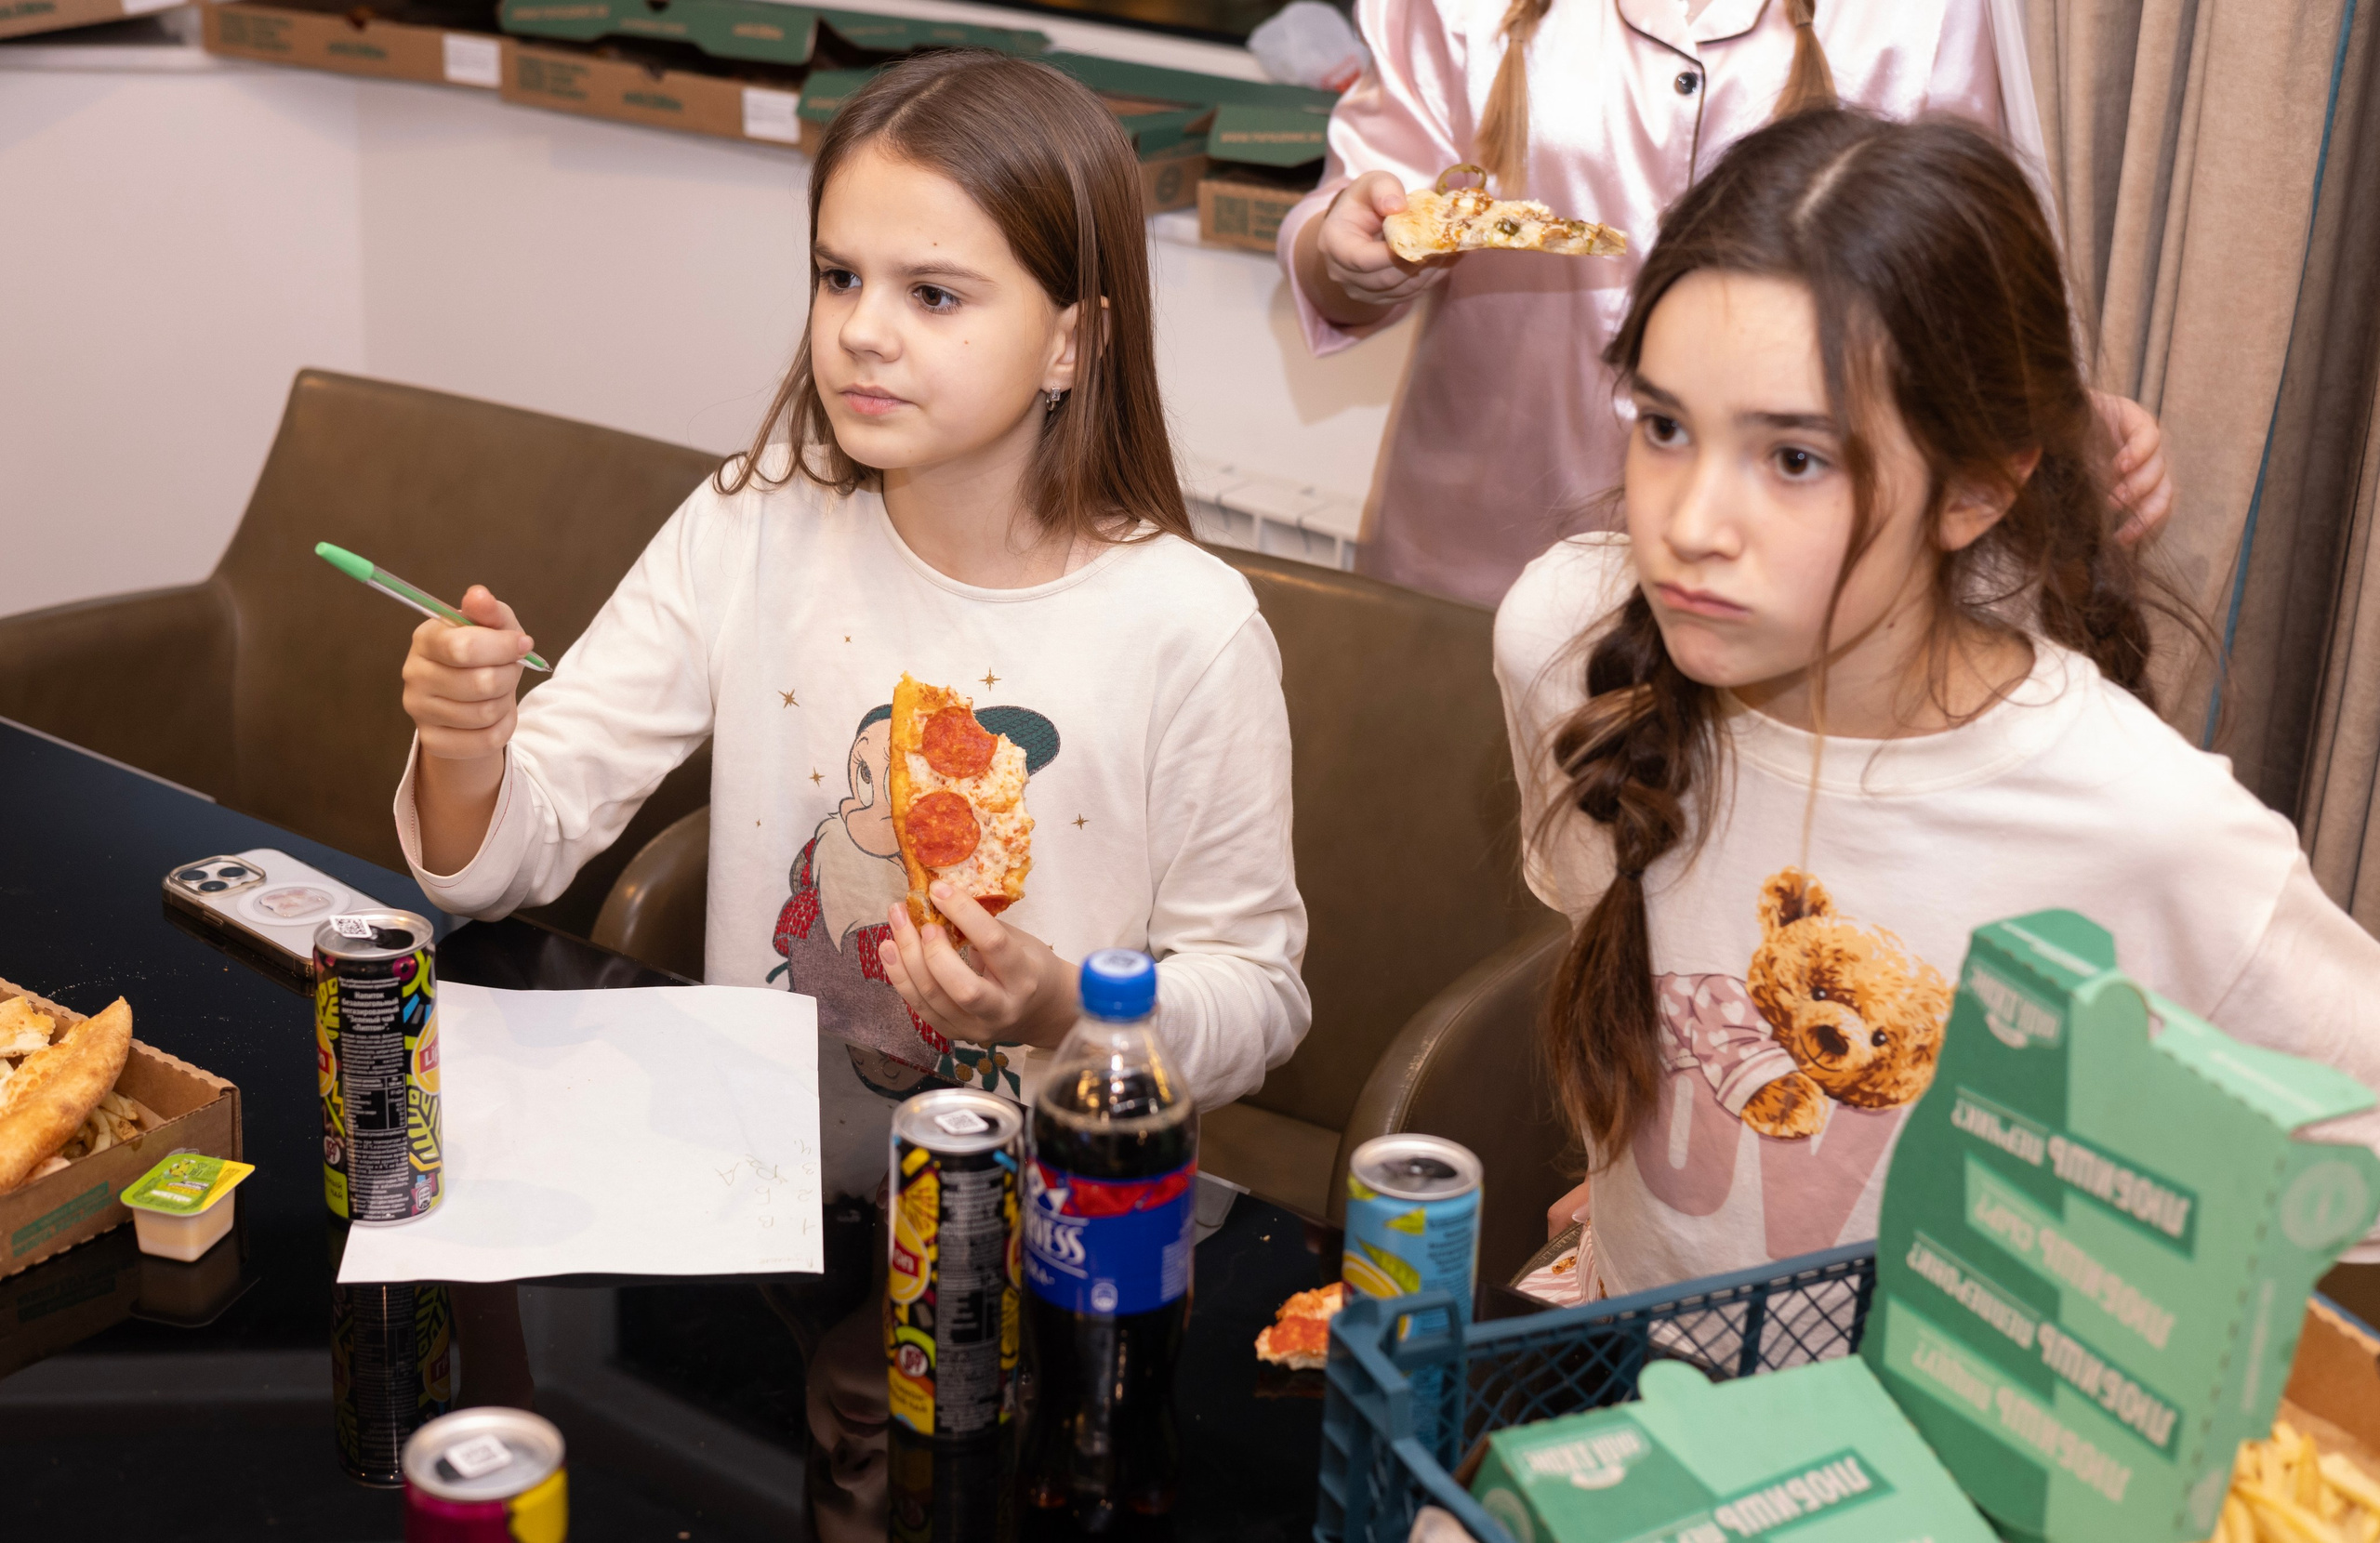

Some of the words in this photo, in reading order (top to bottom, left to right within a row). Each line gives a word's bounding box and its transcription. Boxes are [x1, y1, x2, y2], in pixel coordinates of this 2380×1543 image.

[341, 997, 399, 1008] безалкогольный
[341, 1006, 400, 1017] негазированный
[354, 991, 385, 999] Напиток
[381, 1014, 395, 1022] чай
[1949, 1095, 2046, 1168] ПЕРЧИК?
[1973, 1190, 2037, 1253] СЫР?
[2047, 1135, 2190, 1237] ЛЮБИШЬ
[1905, 1241, 2035, 1351] ПЕППЕРОНИ?
[2038, 1224, 2176, 1351] ЛЮБИШЬ
[2034, 1320, 2177, 1448] ЛЮБИШЬ
[1991, 1383, 2132, 1503] ЛЮБИШЬ
[1714, 1455, 1871, 1537] ЛЮБИШЬ
